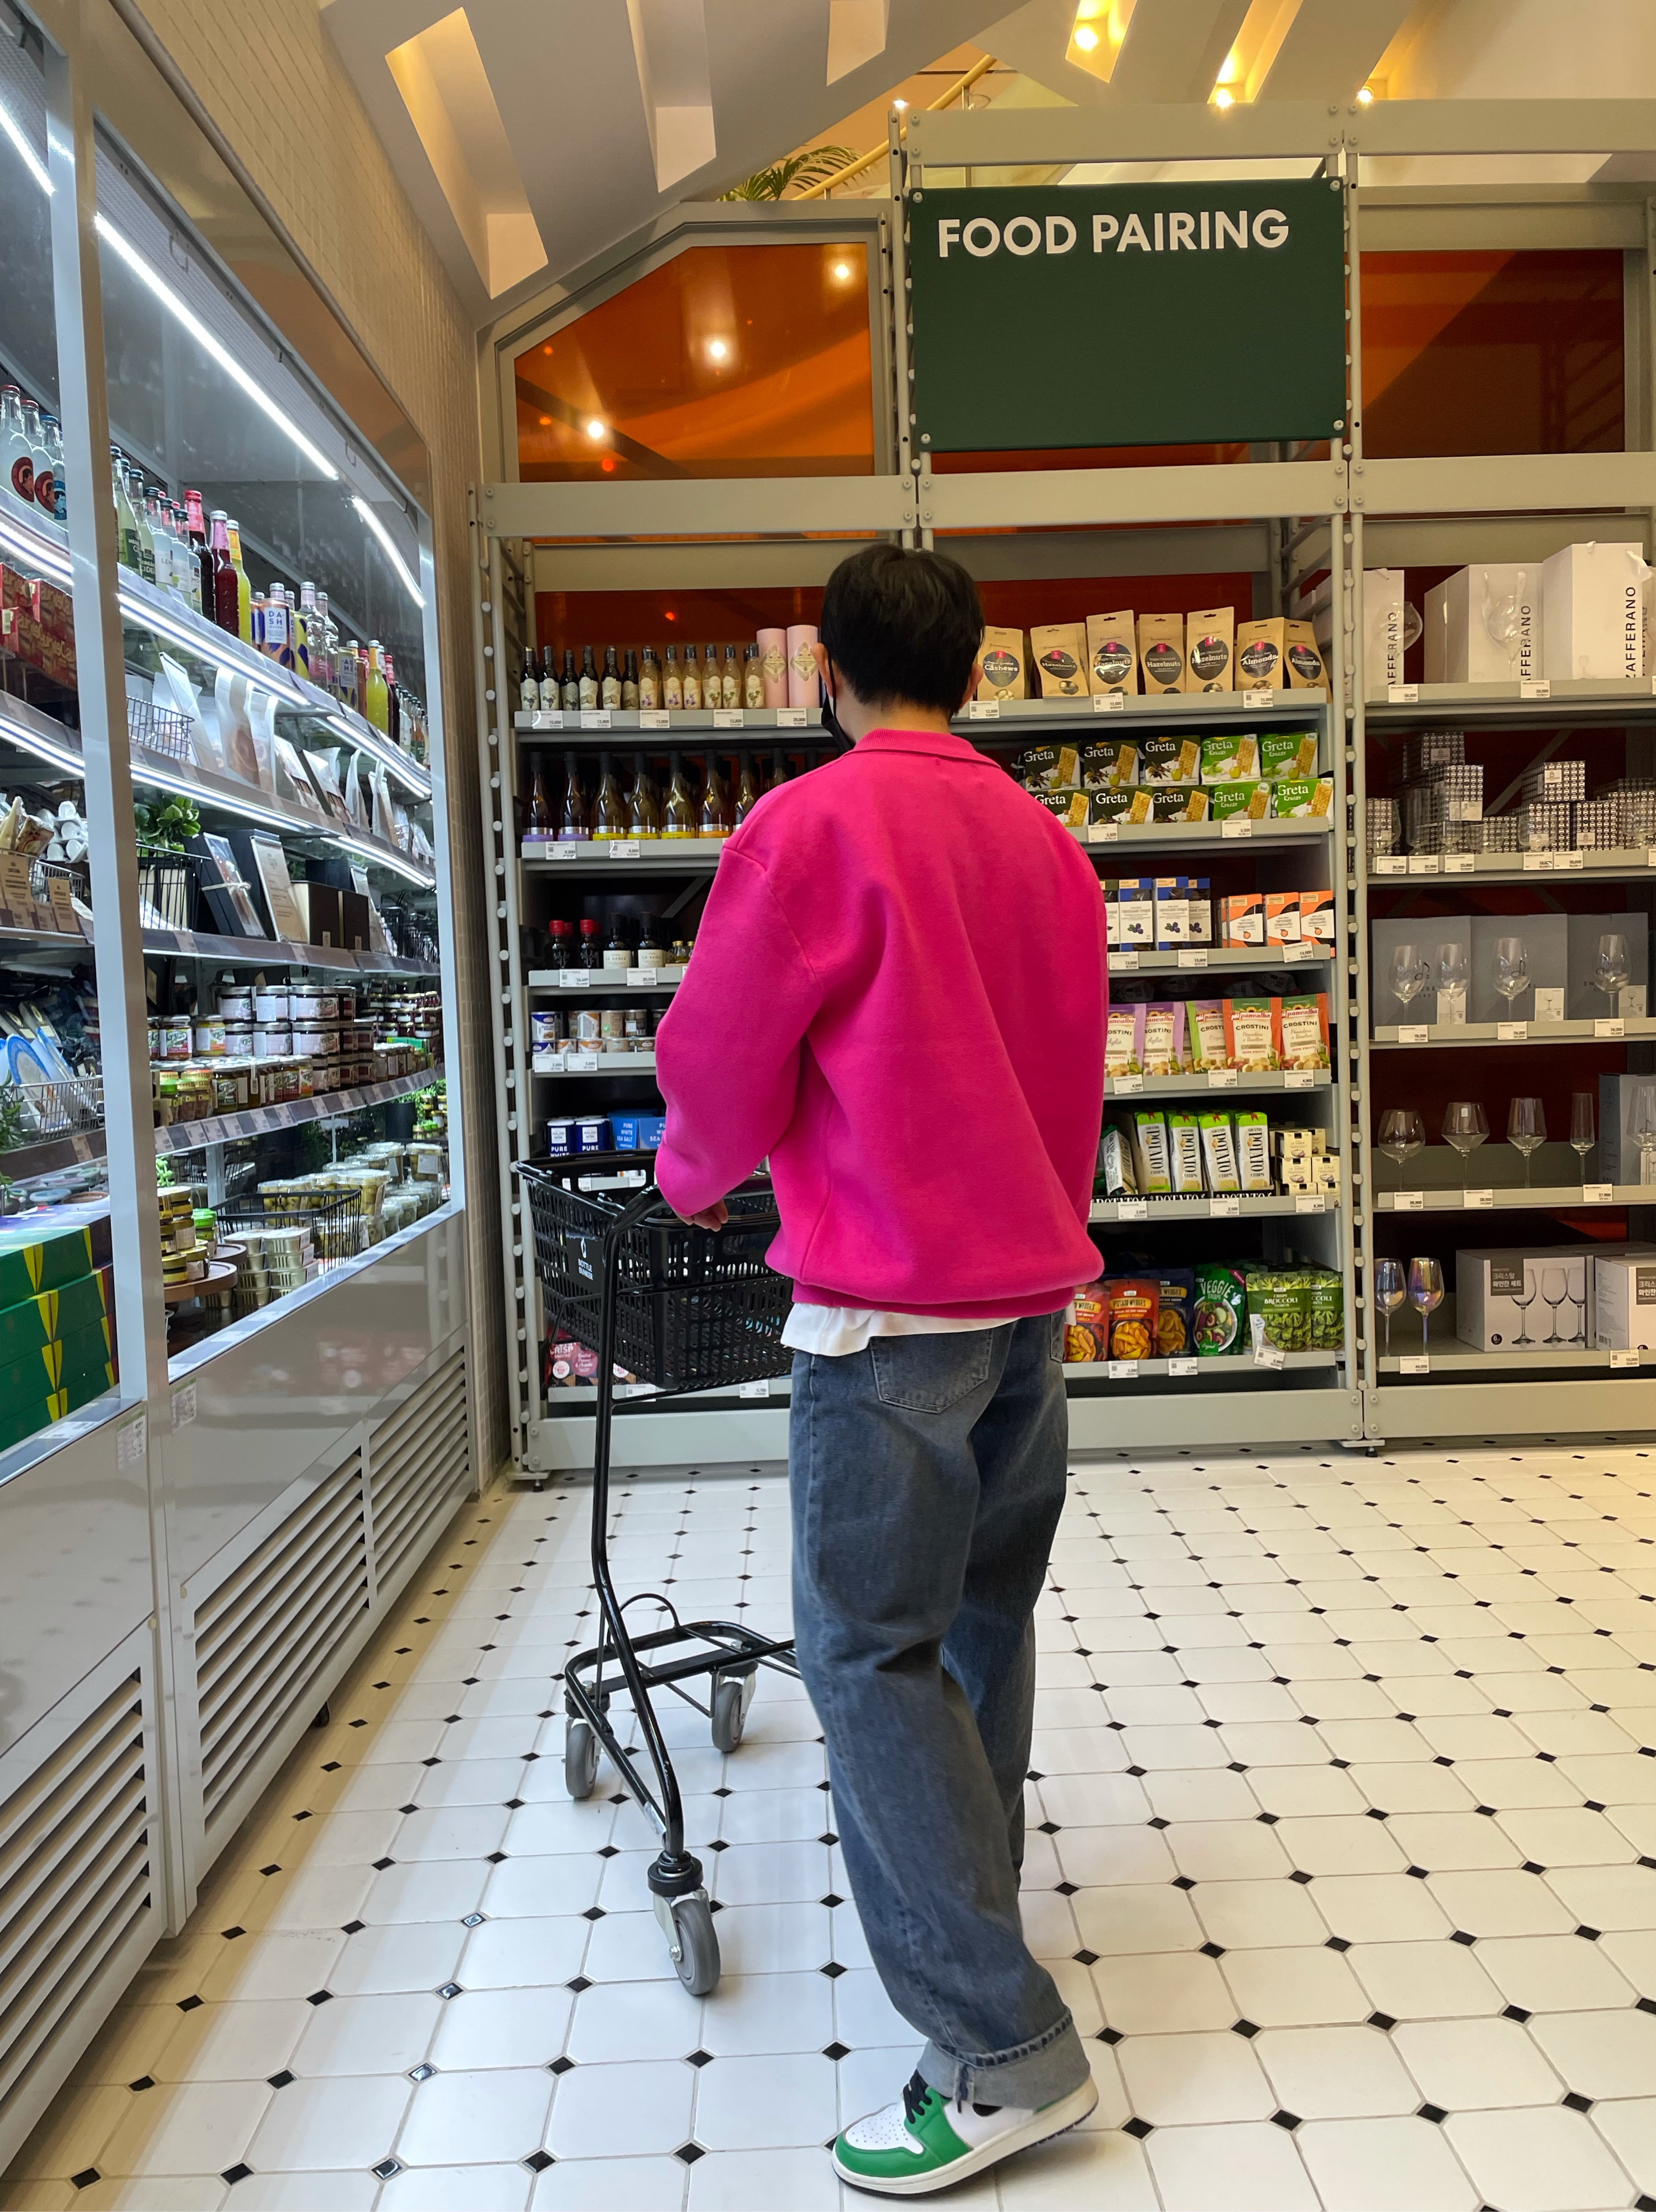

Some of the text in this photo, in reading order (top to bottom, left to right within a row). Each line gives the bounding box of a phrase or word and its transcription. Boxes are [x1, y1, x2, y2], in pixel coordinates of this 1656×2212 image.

[939, 209, 1289, 257] FOOD PAIRING
[1387, 612, 1399, 685] AFFERANO
[1520, 605, 1531, 681] FFERANO
[1191, 654, 1228, 664] Hazelnuts
[1242, 654, 1277, 665] Almonds
[1292, 658, 1320, 666] Almonds
[1145, 741, 1176, 752] Greta
[1203, 740, 1233, 751] Greta
[1262, 741, 1294, 752] Greta
[1024, 751, 1054, 762] Greta
[1084, 747, 1114, 758] Greta
[1278, 784, 1309, 796] Greta
[1034, 794, 1066, 805] Greta
[1096, 793, 1128, 804] Greta
[1153, 792, 1184, 804] Greta
[1214, 791, 1245, 803] Greta
[1147, 1037, 1163, 1045] Aglio
[1147, 1130, 1164, 1169] POTATO
[1181, 1133, 1197, 1173] POTATO
[1212, 1132, 1232, 1173] POTATO
[1248, 1132, 1264, 1172] POTATO
[1200, 1280, 1235, 1299] VEGGIE
[1079, 1302, 1095, 1310] WEDGES
